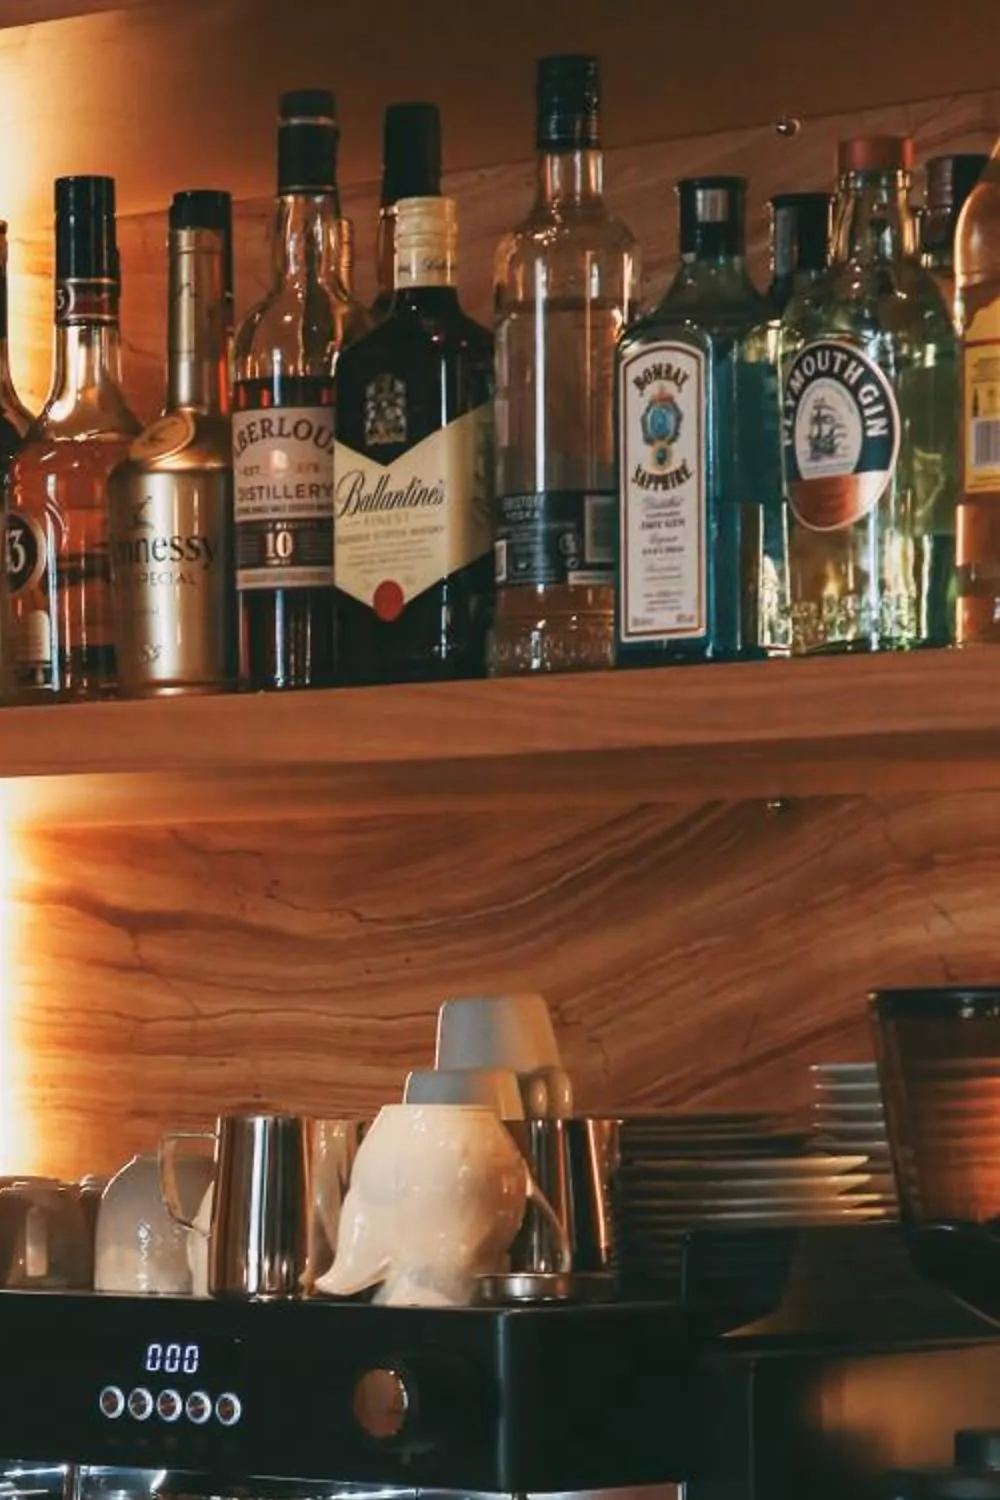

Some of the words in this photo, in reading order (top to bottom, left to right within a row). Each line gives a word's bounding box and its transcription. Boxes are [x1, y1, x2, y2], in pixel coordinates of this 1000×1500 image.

[632, 362, 690, 397] BOMBAY
[859, 383, 889, 436] GIN
[631, 458, 694, 492] SAPPHIRE
[336, 467, 445, 518] Ballantine's
[266, 532, 293, 557] 10
[145, 1343, 199, 1374] 000
